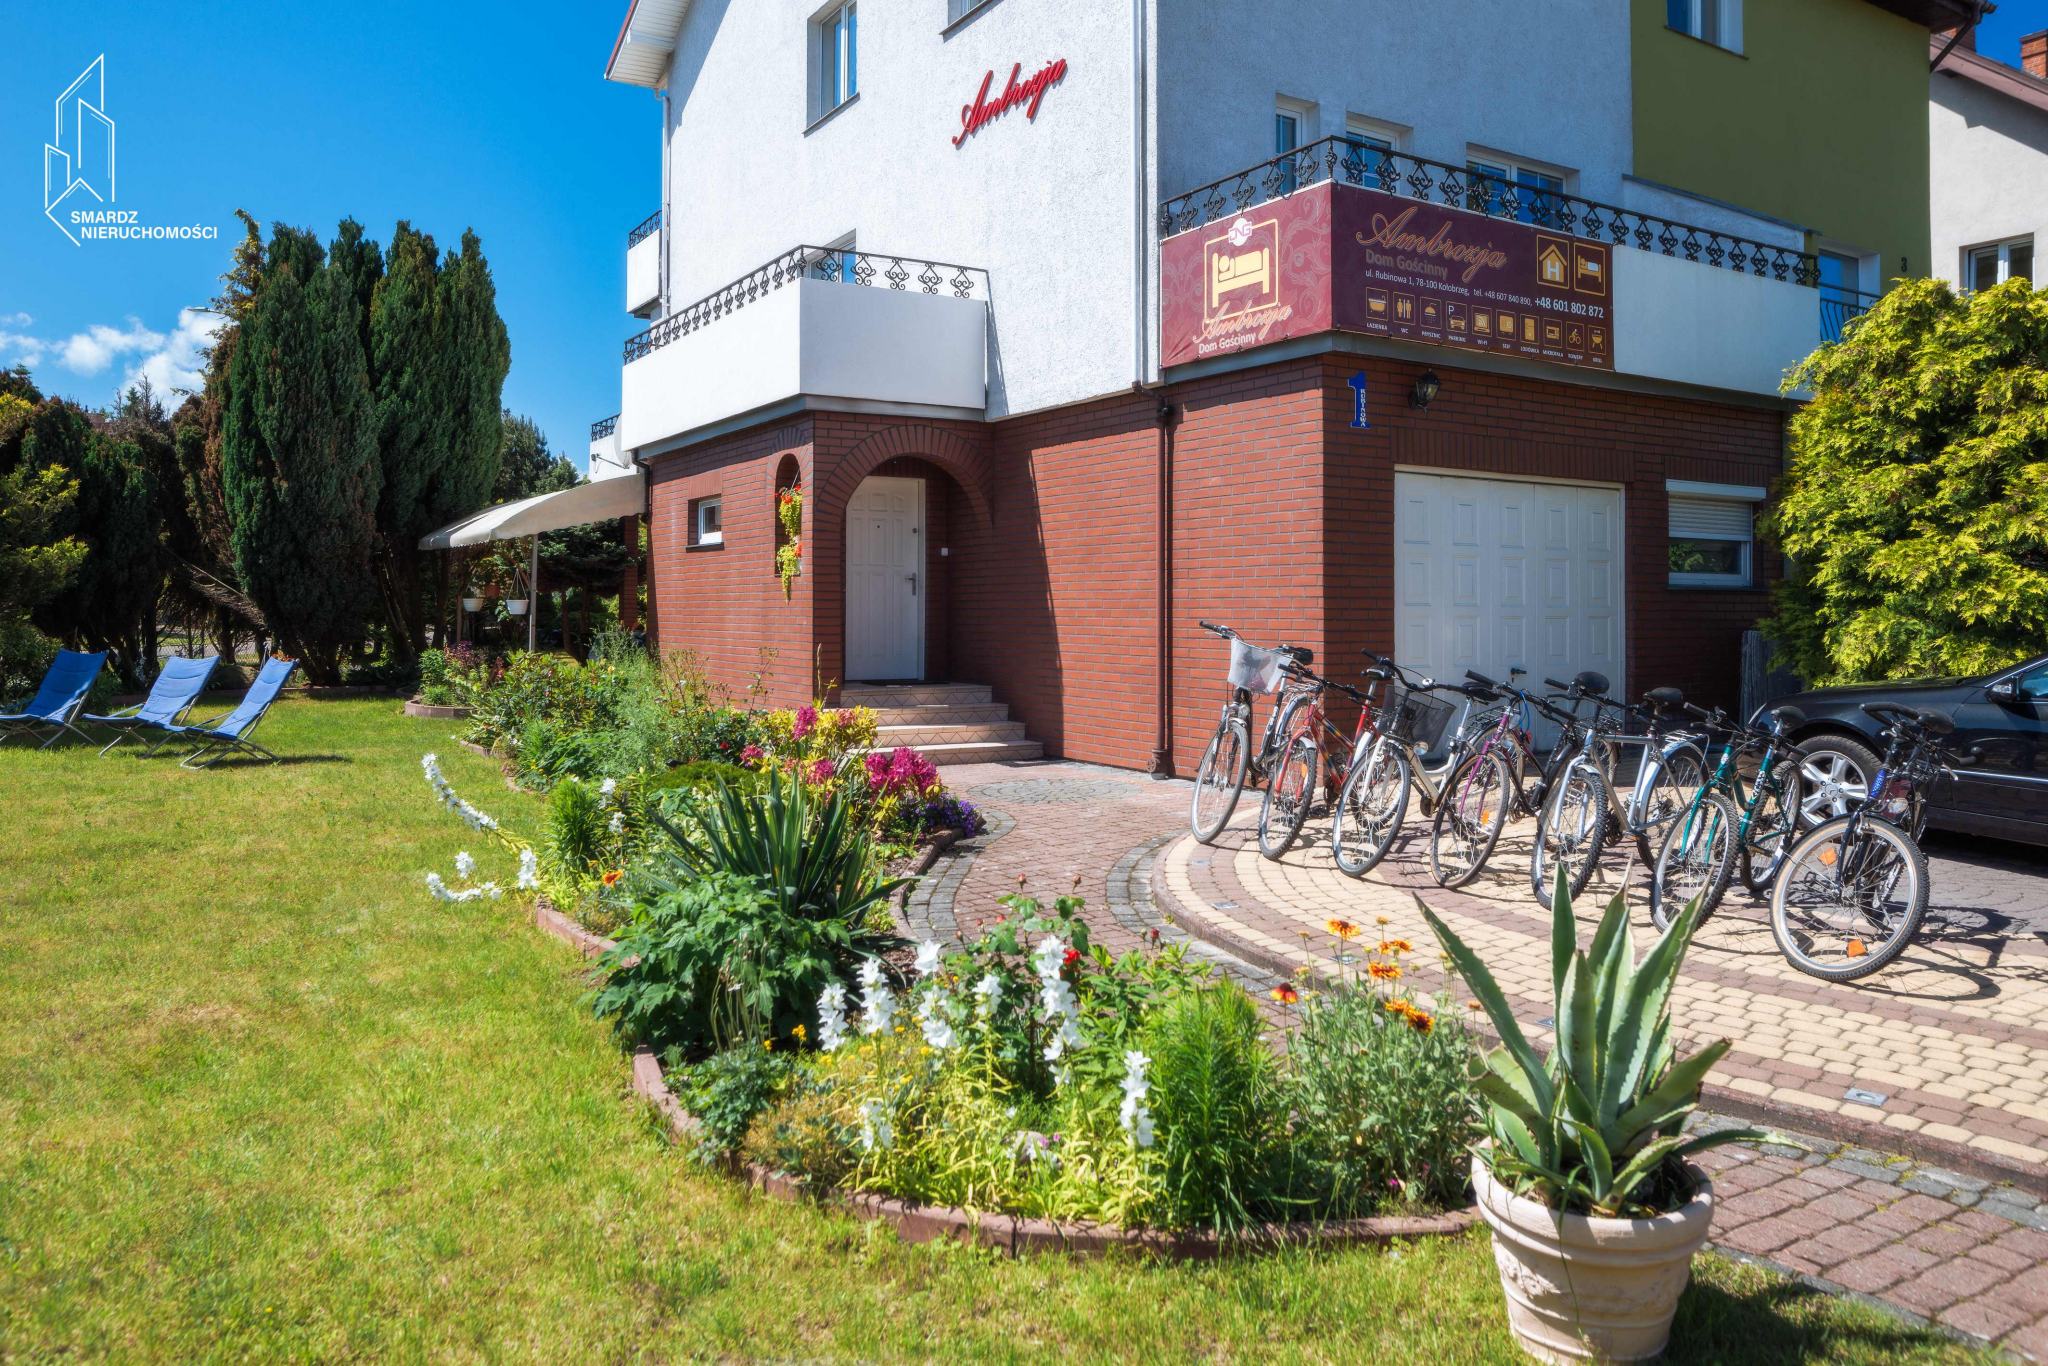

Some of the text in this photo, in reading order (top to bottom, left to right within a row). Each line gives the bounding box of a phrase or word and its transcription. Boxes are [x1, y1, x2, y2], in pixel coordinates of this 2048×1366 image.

[1355, 206, 1507, 283] Ambrozja
[1366, 249, 1448, 281] Dom Gościnny
[1547, 260, 1560, 282] H
[1901, 256, 1908, 273] 3
[1365, 269, 1374, 278] ul.
[1375, 270, 1407, 284] Rubinowa
[1408, 276, 1415, 287] 1,
[1416, 277, 1438, 289] 78-100
[1473, 288, 1483, 297] tel.
[1484, 290, 1496, 299] +48
[1496, 292, 1507, 301] 607
[1534, 296, 1551, 309] +48
[1553, 299, 1569, 312] 601
[1571, 301, 1587, 316] 802
[1588, 304, 1604, 319] 872
[1448, 305, 1455, 315] P
[1192, 299, 1293, 344] Ambrozja
[1198, 332, 1257, 354] Dom Gościnny
[1347, 371, 1371, 430] 1
